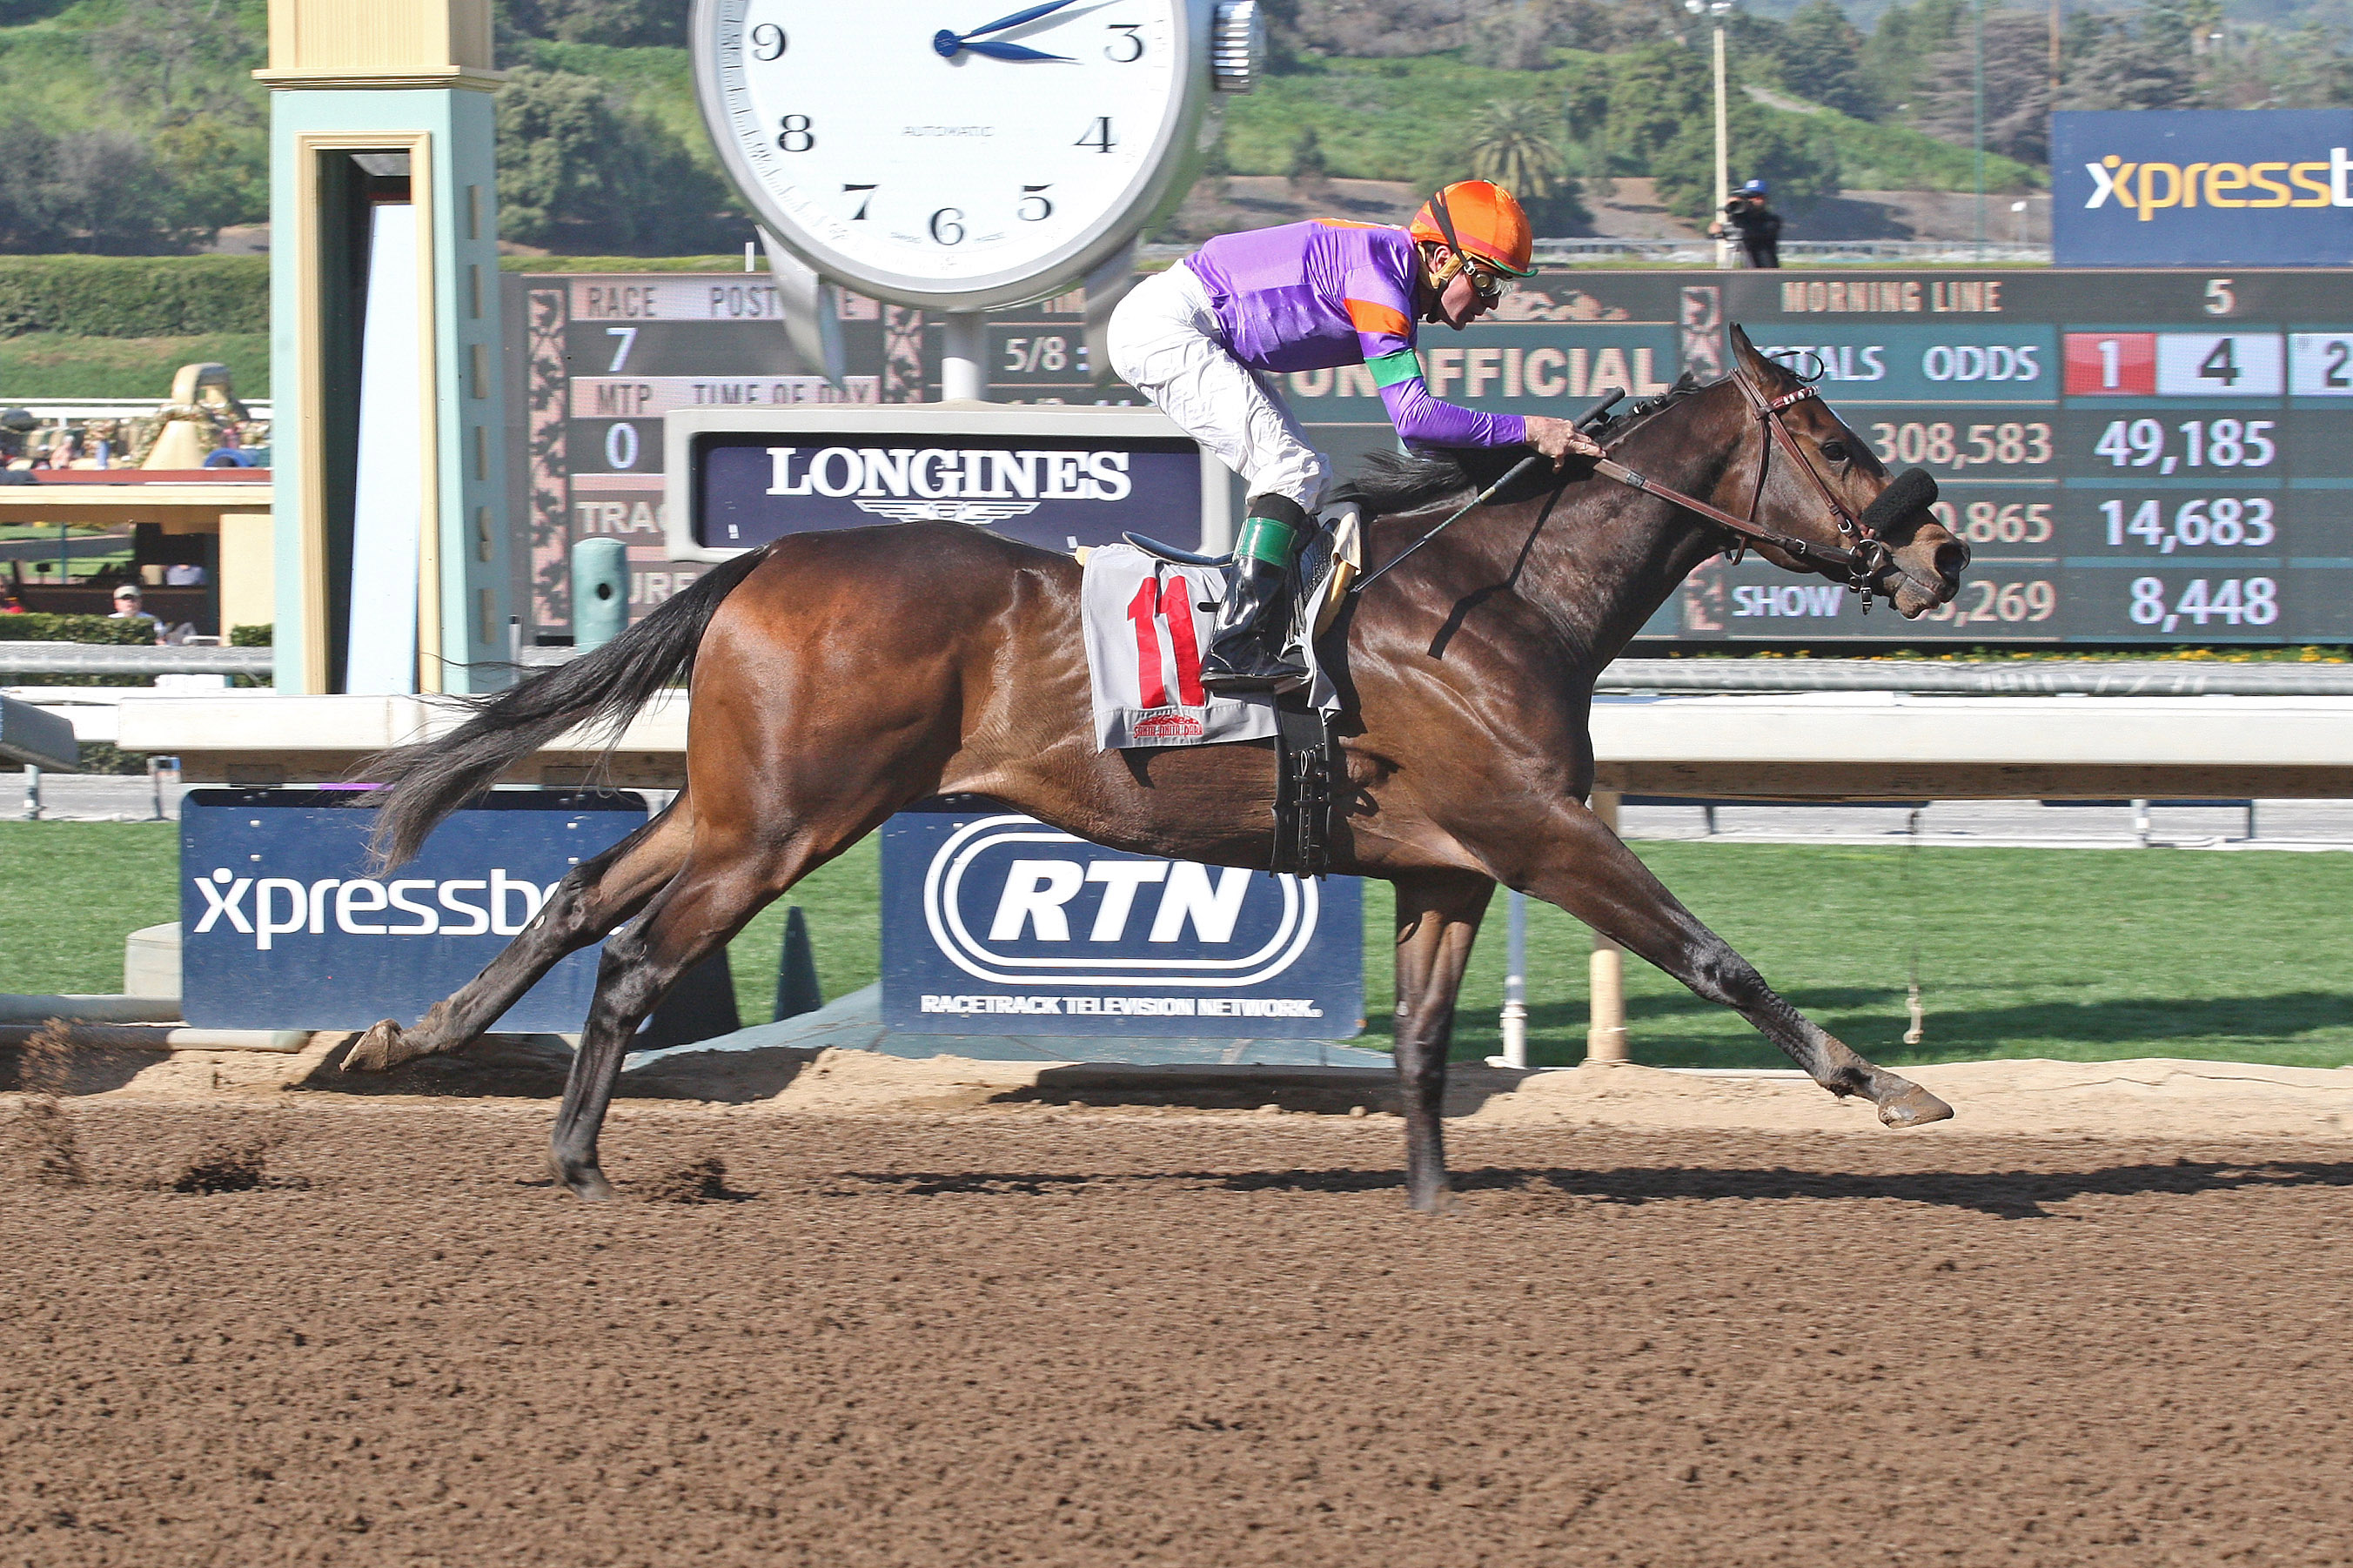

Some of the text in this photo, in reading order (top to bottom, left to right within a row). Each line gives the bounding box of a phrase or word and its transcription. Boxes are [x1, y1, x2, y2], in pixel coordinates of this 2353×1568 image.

[752, 23, 787, 62] 9
[1104, 23, 1144, 64] 3
[778, 114, 815, 152] 8
[1074, 115, 1117, 154] 4
[842, 184, 881, 221] 7
[1017, 184, 1055, 222] 5
[928, 206, 966, 246] 6
[587, 286, 655, 317] RACE
[710, 285, 776, 317] POST
[1781, 281, 2001, 312] MORNING LINE
[2202, 278, 2235, 314] 5
[606, 327, 638, 372] 7
[1004, 337, 1067, 372] 5/8
[1753, 345, 2041, 381] TALS ODDS
[2098, 338, 2240, 388] 1 4
[2325, 340, 2350, 386] 2
[1289, 348, 1669, 397] UNFFICIAL
[596, 385, 651, 414] MTP
[605, 423, 639, 469] 0
[1871, 422, 2055, 469] 308,583
[2094, 418, 2276, 474] 49,185
[766, 446, 1131, 502] LONGINES
[574, 501, 667, 534] TRA
[2098, 498, 2276, 553] 14,683
[1732, 586, 1844, 616] SHOW
[1904, 580, 2056, 627] ,269
[2128, 576, 2279, 633] 8,448
[1127, 575, 1205, 709] 11
[193, 868, 624, 950] xpressb
[988, 858, 1253, 944] RTN
[921, 995, 1062, 1015] RACETRACK
[1063, 996, 1196, 1016] TELEVISION
